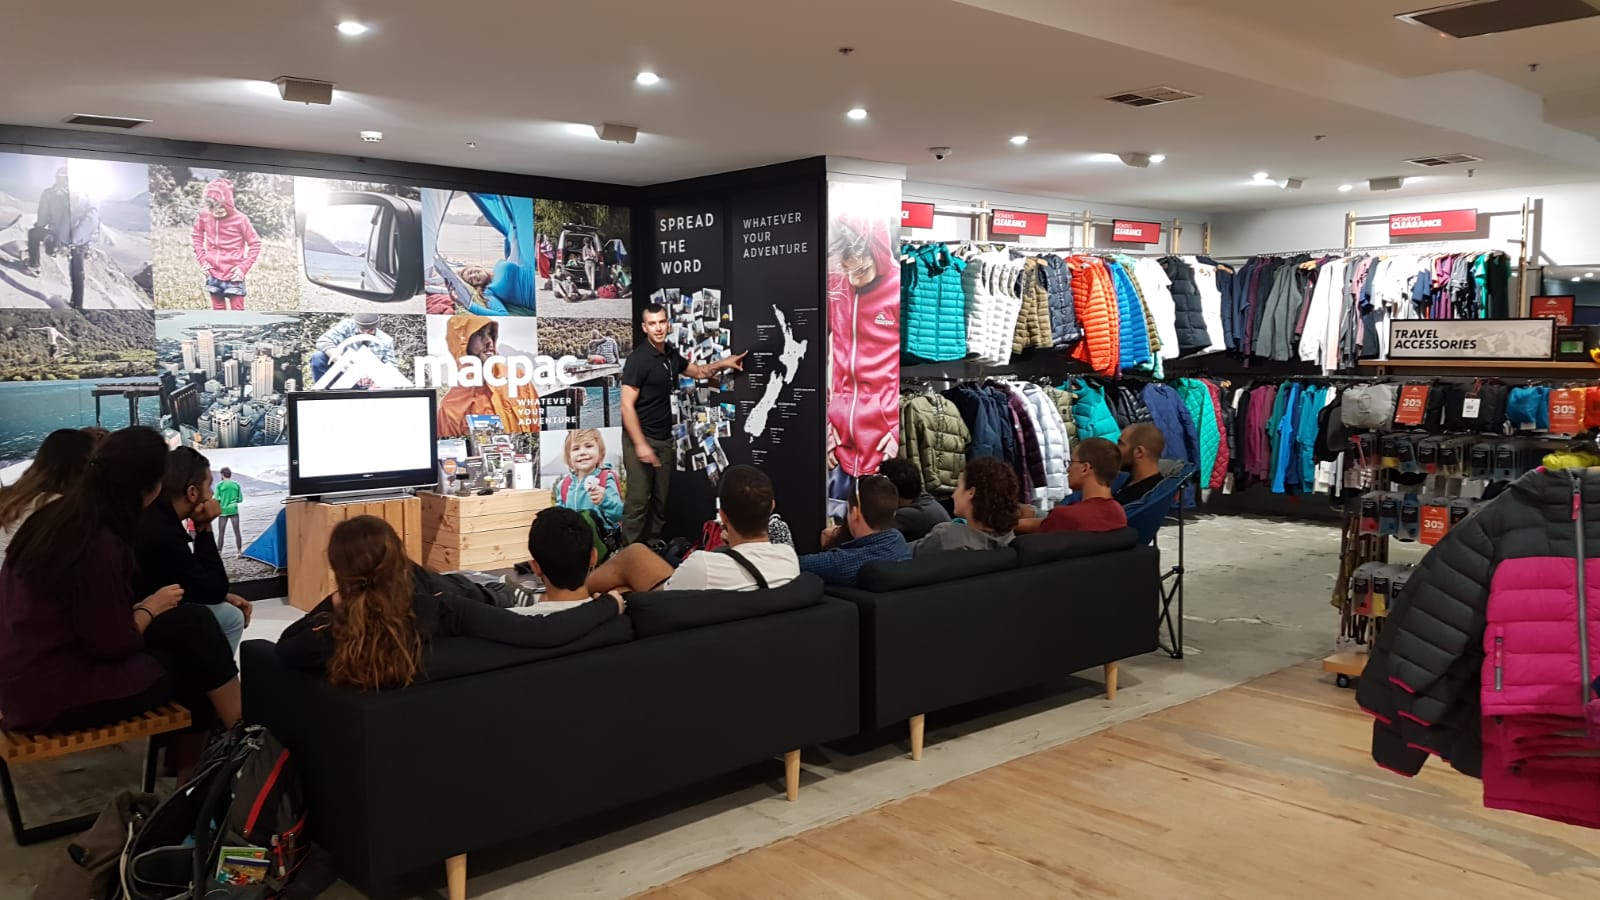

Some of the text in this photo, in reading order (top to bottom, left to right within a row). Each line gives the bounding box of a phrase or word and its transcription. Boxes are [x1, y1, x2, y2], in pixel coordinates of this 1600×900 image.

[659, 213, 714, 232] SPREAD
[743, 212, 802, 229] WHATEVER
[1391, 218, 1442, 229] CLEARANCE
[743, 231, 771, 243] YOUR
[660, 239, 686, 254] THE
[743, 242, 808, 258] ADVENTURE
[660, 259, 702, 274] WORD
[1394, 329, 1439, 339] TRAVEL
[1394, 339, 1477, 350] ACCESSORIES
[414, 354, 578, 398] macpac
[517, 397, 572, 406] WHATEVER
[518, 408, 545, 416] YOUR
[518, 416, 577, 426] ADVENTURE
